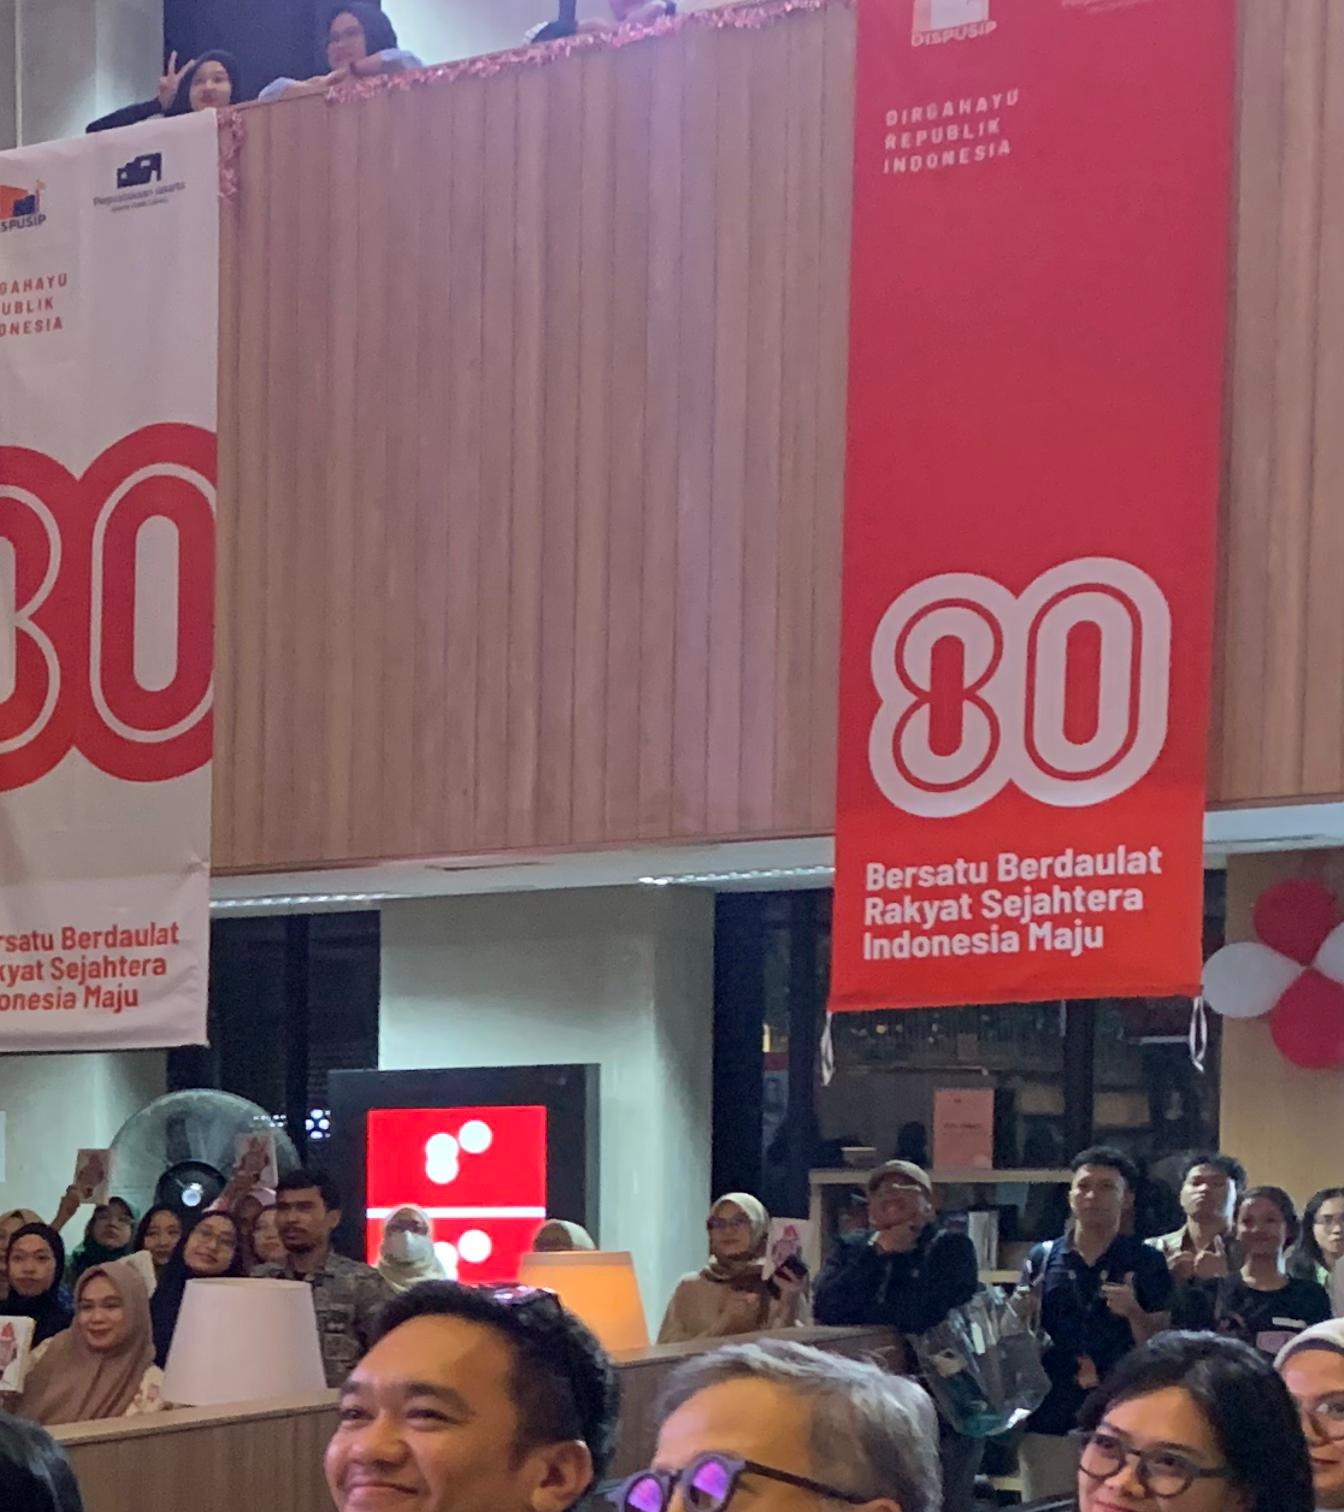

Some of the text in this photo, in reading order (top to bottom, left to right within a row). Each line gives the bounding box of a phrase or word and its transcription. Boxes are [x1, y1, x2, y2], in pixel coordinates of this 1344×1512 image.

[885, 88, 1020, 127] DIRGAHAYU
[884, 117, 1002, 151] REPUBLIK
[882, 138, 1012, 175] INDONESIA
[868, 556, 1171, 818] 80
[865, 845, 1163, 891] Bersatu Berdaulat
[864, 886, 1143, 930] Rakyat Sejahtera
[61, 922, 180, 949] Berdaulat
[864, 921, 1104, 960] Indonesia Maju
[51, 954, 167, 984] Sejahtera
[84, 983, 139, 1013] Maju
